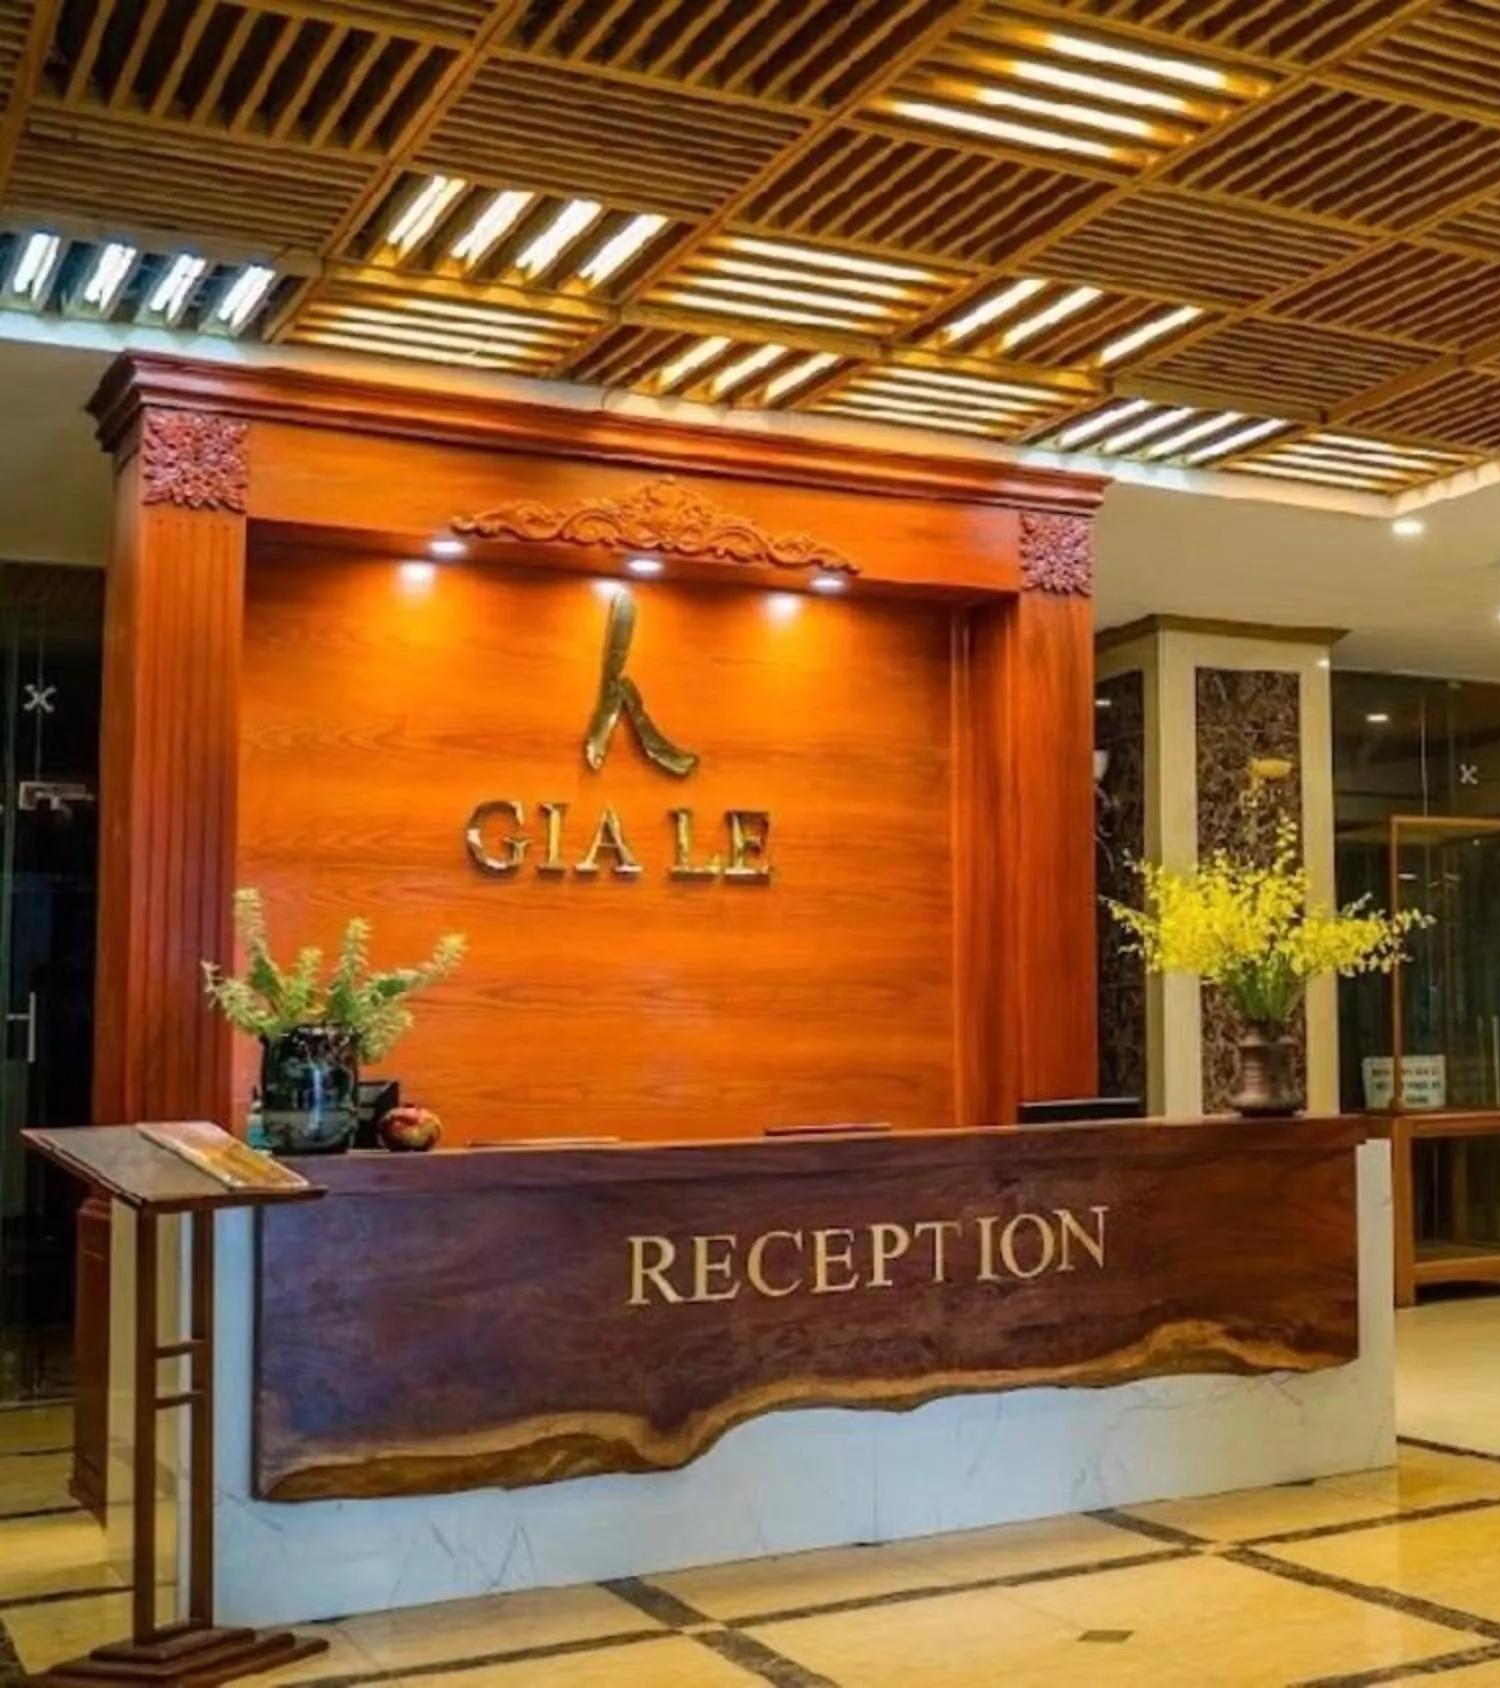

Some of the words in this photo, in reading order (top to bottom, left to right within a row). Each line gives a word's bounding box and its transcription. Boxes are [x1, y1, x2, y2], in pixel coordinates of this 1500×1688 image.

[466, 800, 643, 879] GIA
[668, 808, 771, 884] LE
[625, 1206, 1109, 1305] RECEPTION
